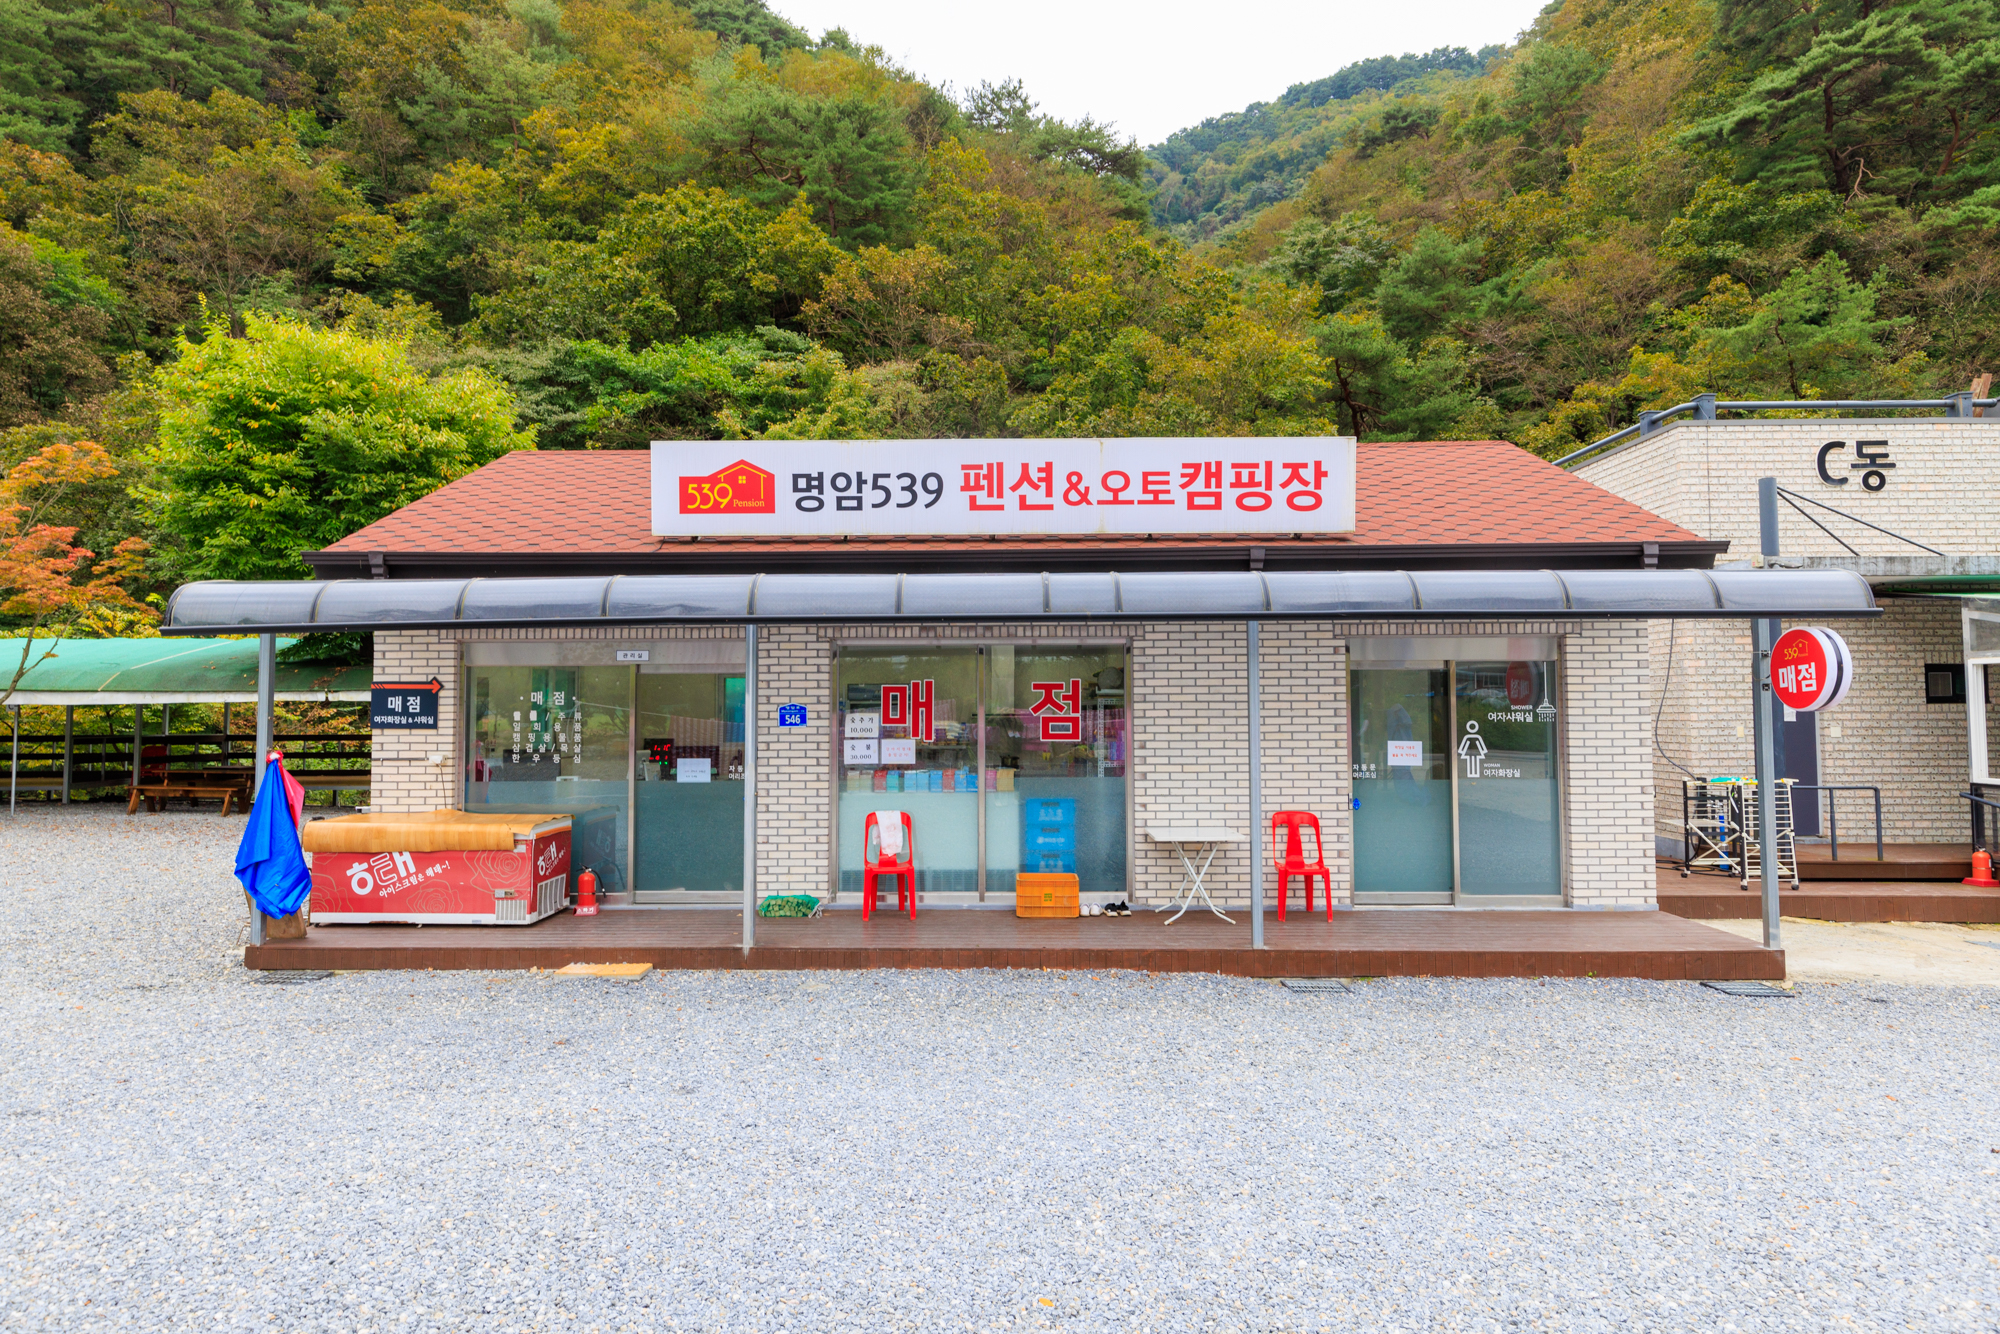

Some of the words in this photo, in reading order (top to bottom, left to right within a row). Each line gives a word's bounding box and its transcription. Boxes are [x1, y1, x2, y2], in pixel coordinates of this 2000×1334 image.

[1817, 440, 1896, 491] C동
[687, 483, 732, 509] 539
[733, 498, 765, 507] Pension
[792, 471, 944, 512] 명암539
[1784, 647, 1799, 660] 539
[1778, 662, 1817, 693] 매점
[387, 696, 420, 713] 매점
[374, 715, 407, 725] 여자화장실
[414, 715, 434, 725] 샤워실
[785, 714, 800, 724] 546
[1488, 712, 1533, 723] 여자샤워실
[1352, 771, 1377, 779] 머리조심
[1484, 768, 1520, 778] 여자화장실
[379, 873, 425, 898] 아이스크림은
